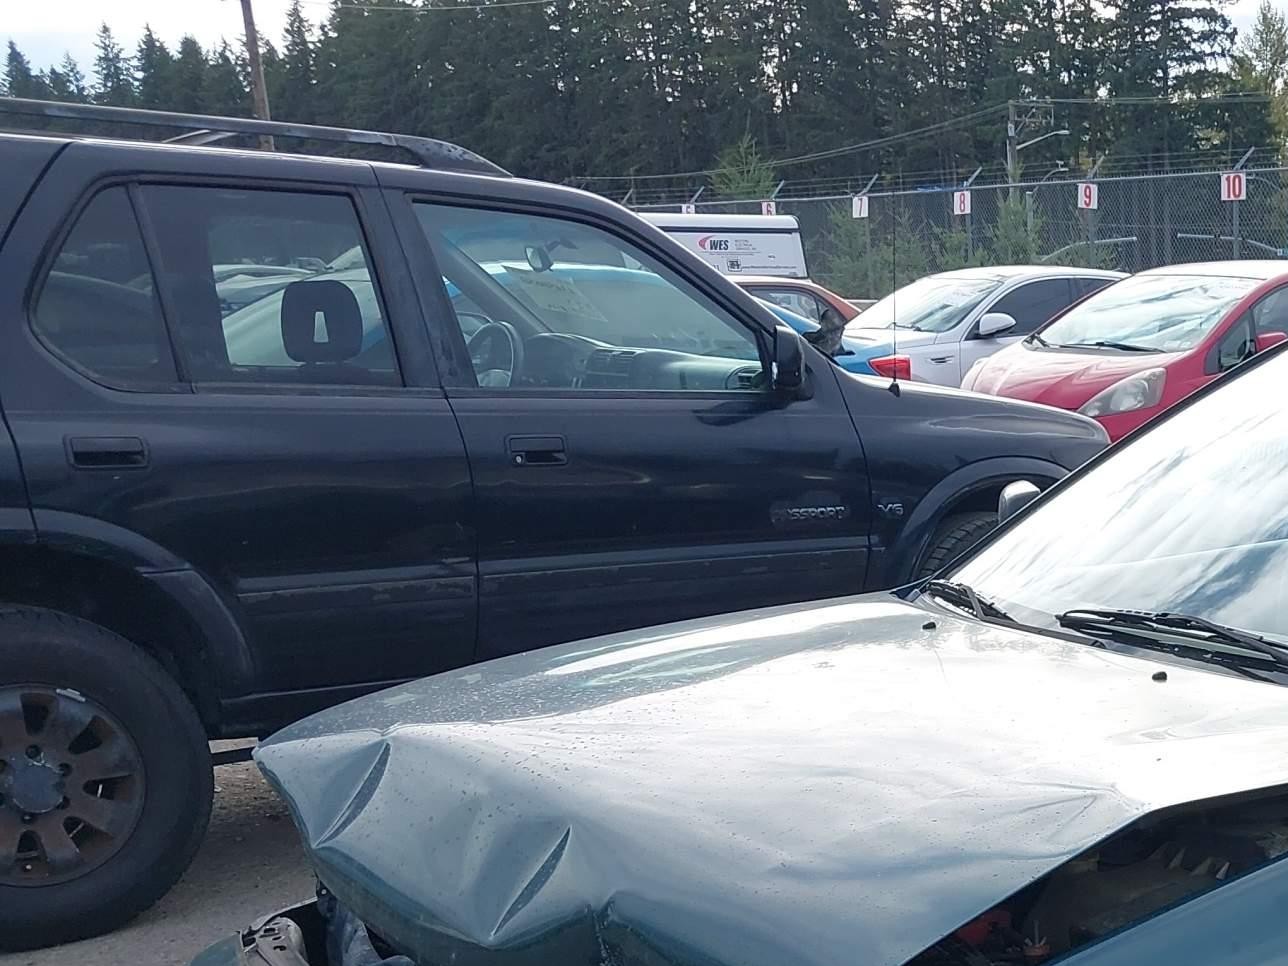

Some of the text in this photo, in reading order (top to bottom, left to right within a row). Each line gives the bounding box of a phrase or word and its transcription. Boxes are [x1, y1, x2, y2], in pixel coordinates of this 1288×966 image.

[1083, 185, 1092, 208] 9
[1225, 174, 1242, 199] 10
[858, 197, 864, 217] 7
[959, 192, 966, 213] 8
[709, 239, 730, 251] WES
